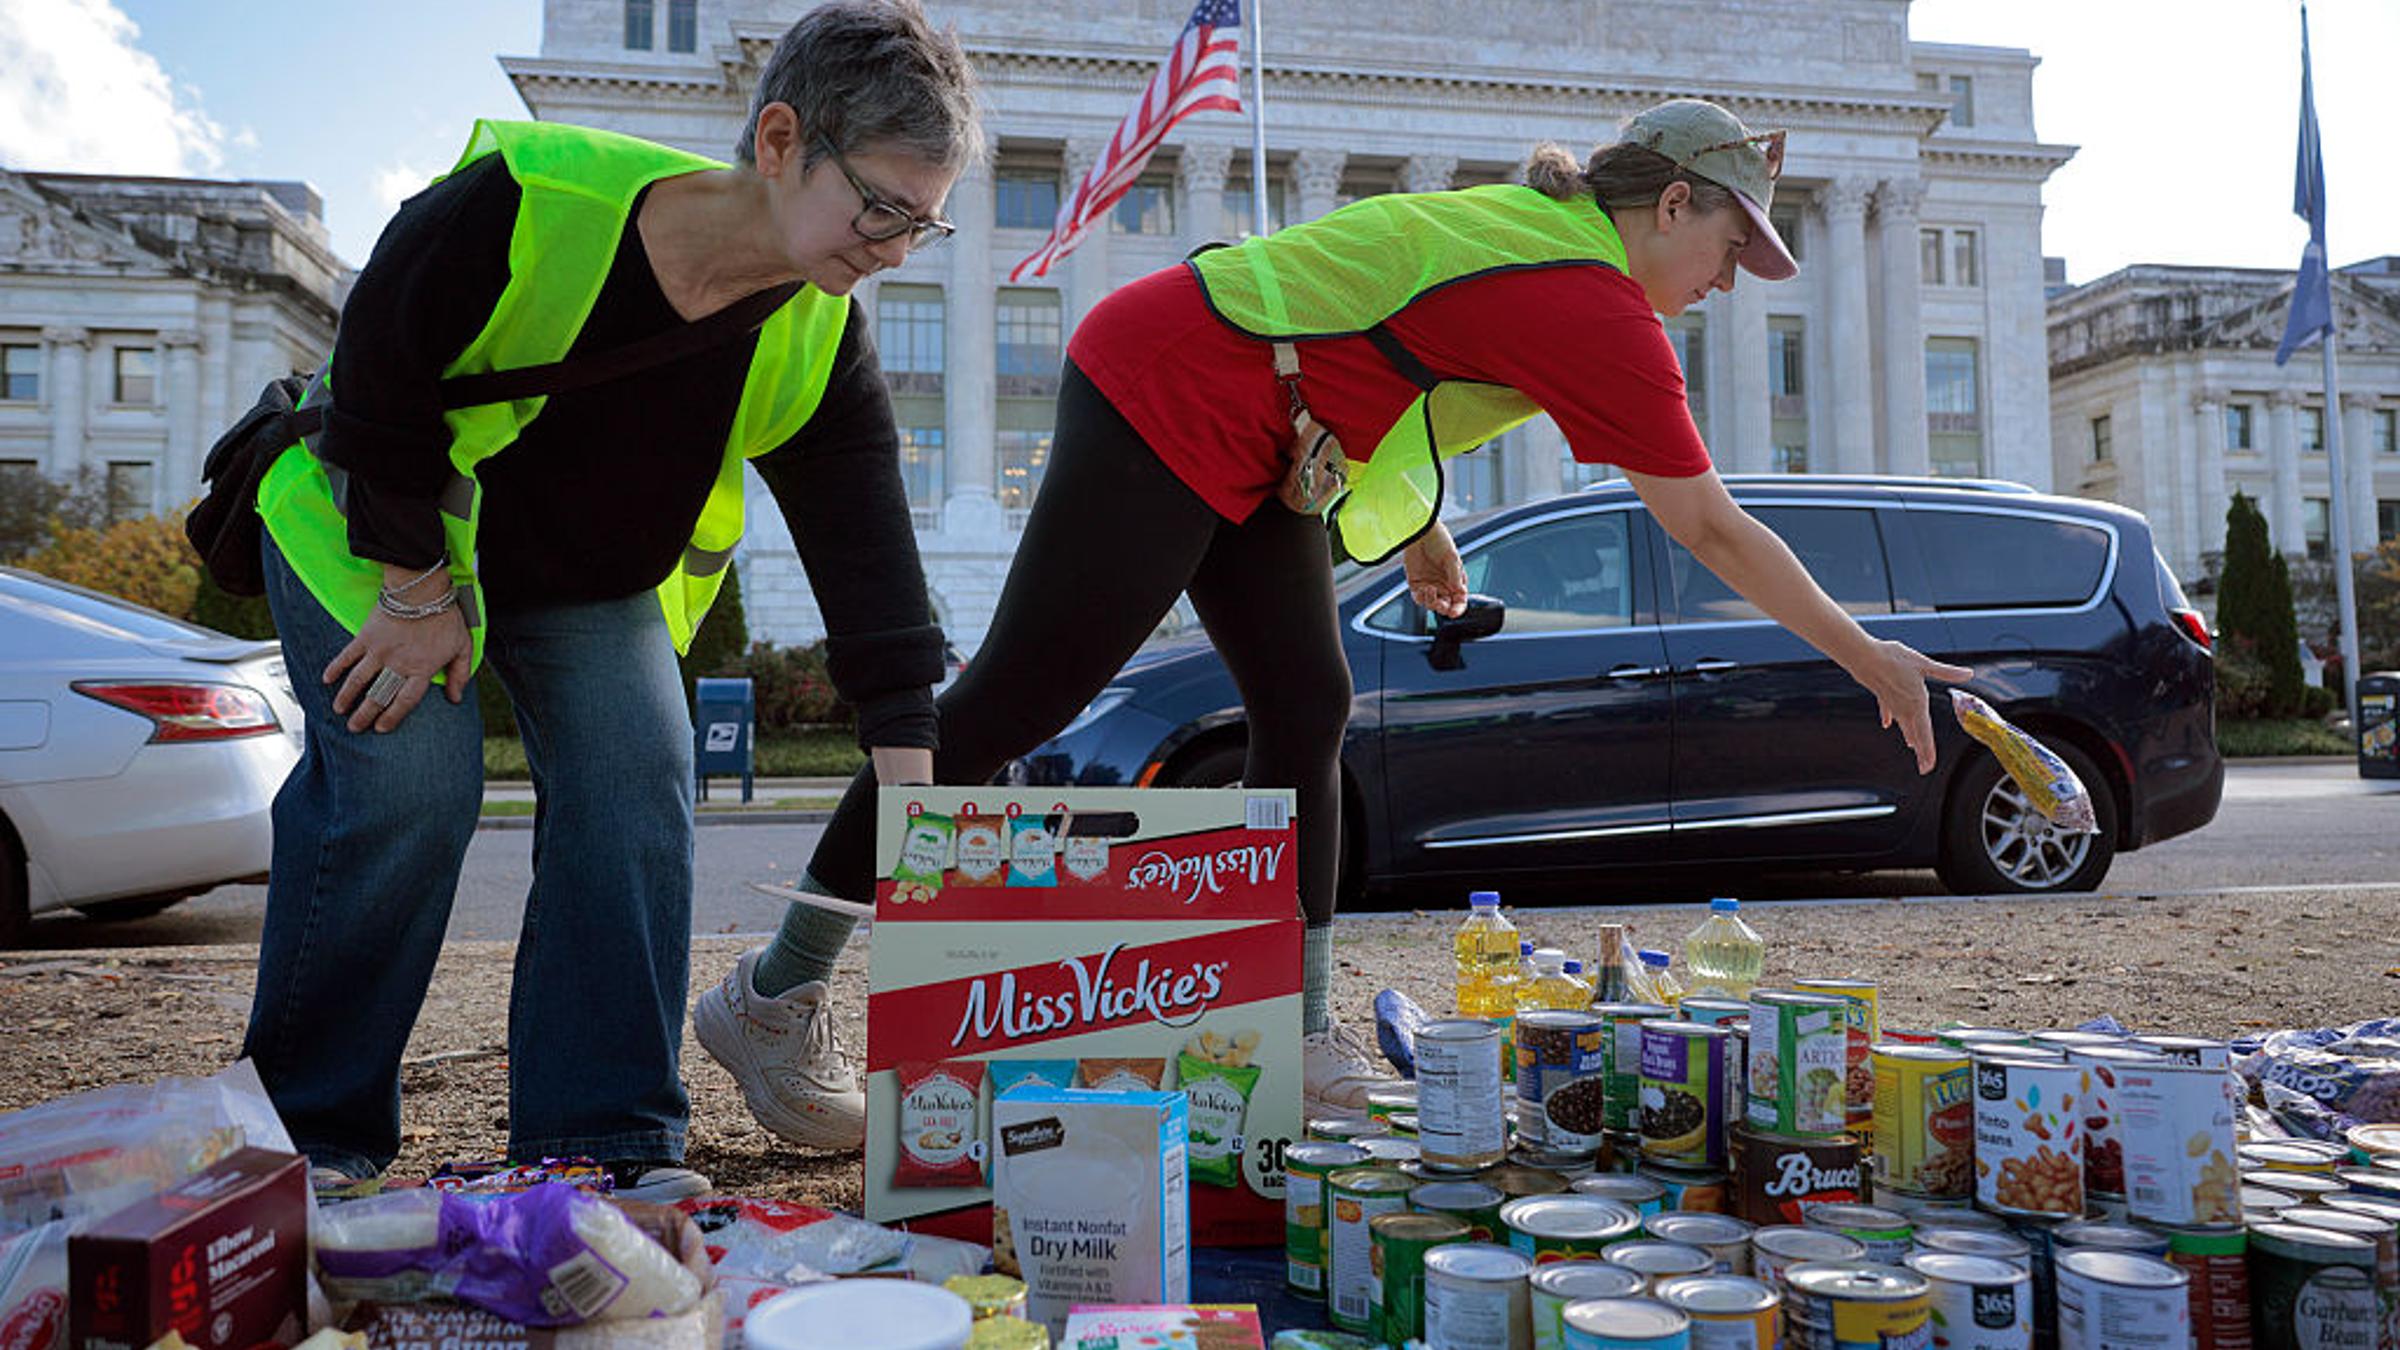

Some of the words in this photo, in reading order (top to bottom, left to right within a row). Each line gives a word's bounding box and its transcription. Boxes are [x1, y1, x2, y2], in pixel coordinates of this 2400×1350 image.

[1129, 850, 1224, 904] Vickie's
[1216, 842, 1286, 882] Miss
[952, 973, 1073, 1047] Miss
[1059, 942, 1222, 1027] Vickie's
[2265, 1061, 2338, 1100] GOYA
[1978, 1111, 2009, 1129] Pinto
[1977, 1128, 2013, 1147] Beans
[1023, 1217, 1073, 1234] Instant
[1078, 1219, 1127, 1236] Nonfat
[208, 1229, 275, 1286] Macaroni
[1031, 1236, 1067, 1262] Dry
[1073, 1238, 1117, 1260] Milk
[1976, 1293, 2012, 1315] 365
